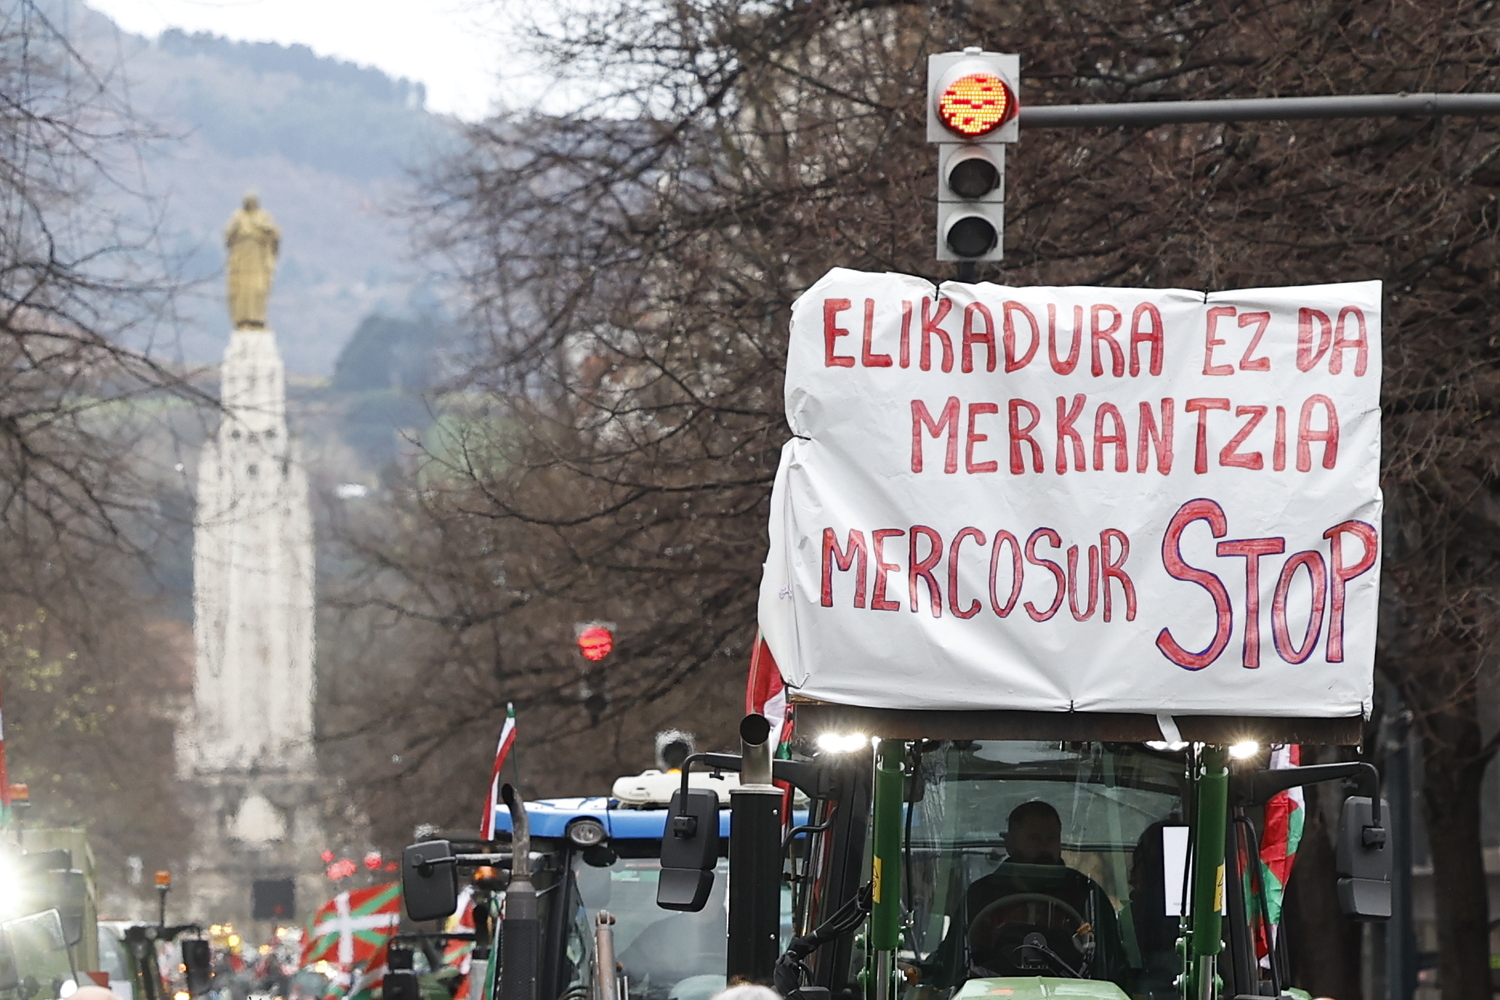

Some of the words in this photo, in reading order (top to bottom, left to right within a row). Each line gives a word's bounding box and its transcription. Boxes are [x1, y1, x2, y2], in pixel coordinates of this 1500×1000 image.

[823, 297, 1165, 377] ELIKADURA
[1202, 306, 1272, 376] EZ
[1296, 306, 1369, 377] DA
[910, 393, 1340, 475] MERKANTZIA
[821, 526, 1138, 622] MERCOSUR
